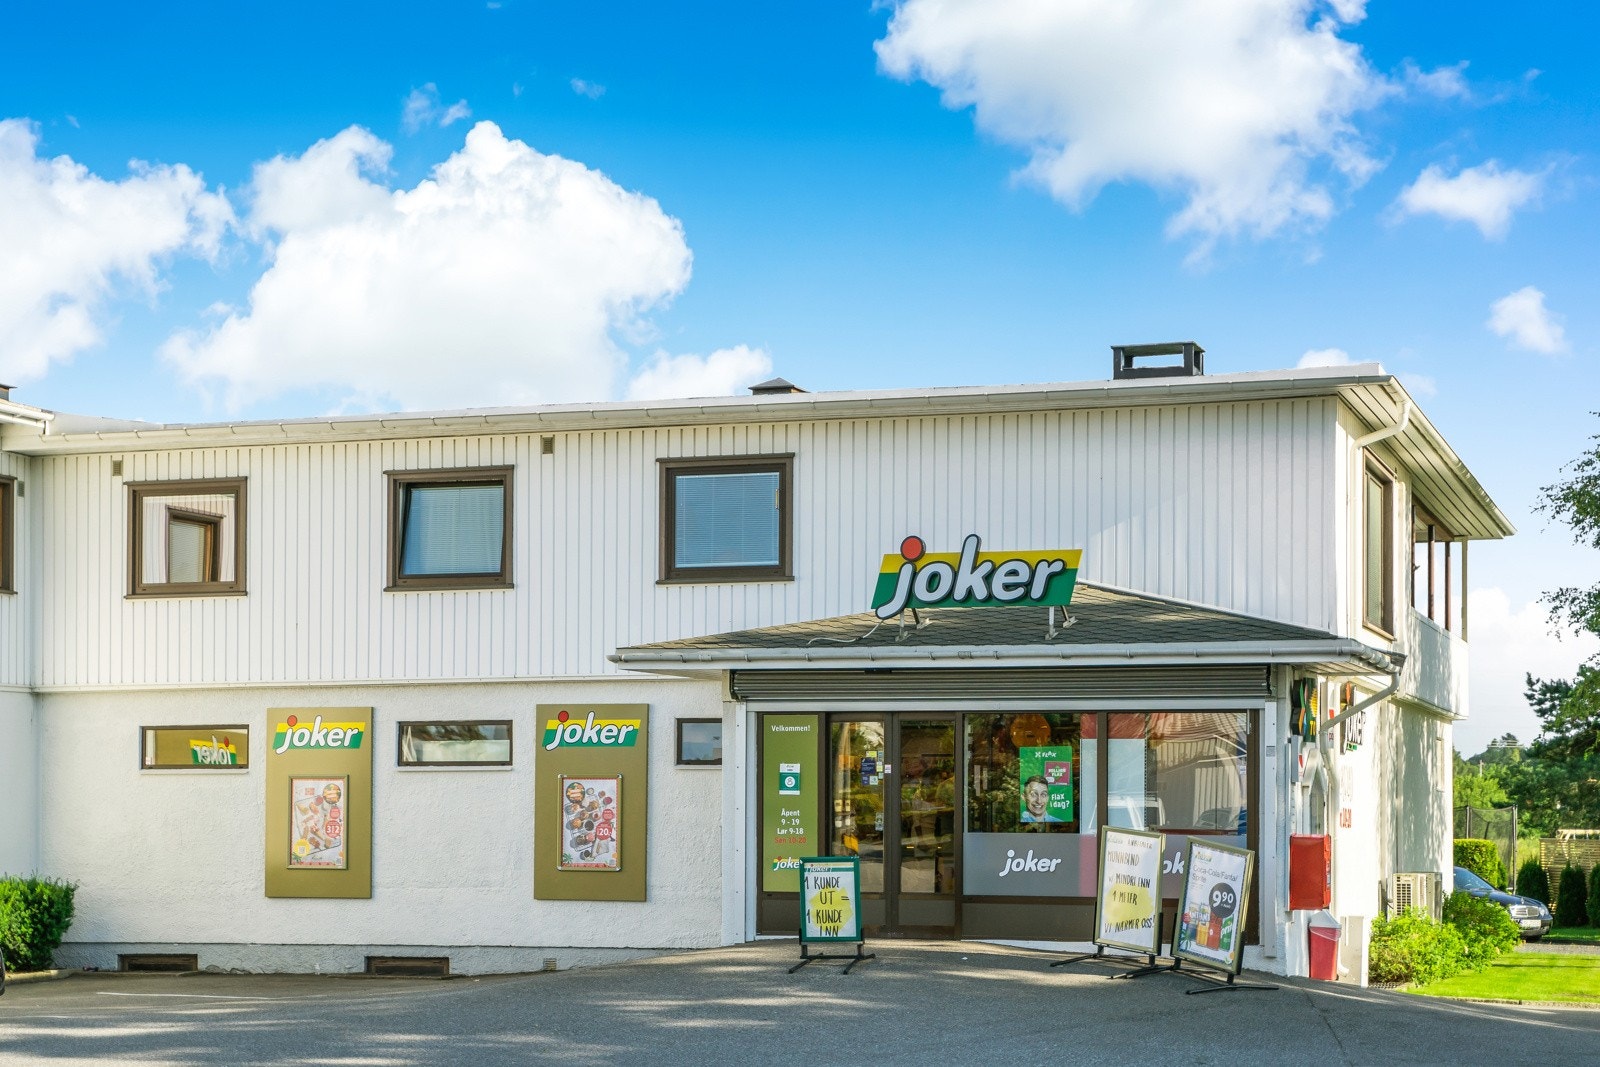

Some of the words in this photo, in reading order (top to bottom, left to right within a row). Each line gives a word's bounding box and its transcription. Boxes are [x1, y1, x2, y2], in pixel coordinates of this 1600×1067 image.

[875, 533, 1067, 620] joker
[275, 714, 359, 755] joker
[545, 710, 635, 751] joker
[1053, 800, 1070, 809] dag?
[781, 808, 800, 818] Åpent
[773, 856, 803, 872] joke
[999, 849, 1062, 877] joker
[814, 876, 841, 890] KUNDE
[820, 890, 835, 905] UT
[806, 909, 811, 924] 1
[816, 909, 842, 924] KUNDE
